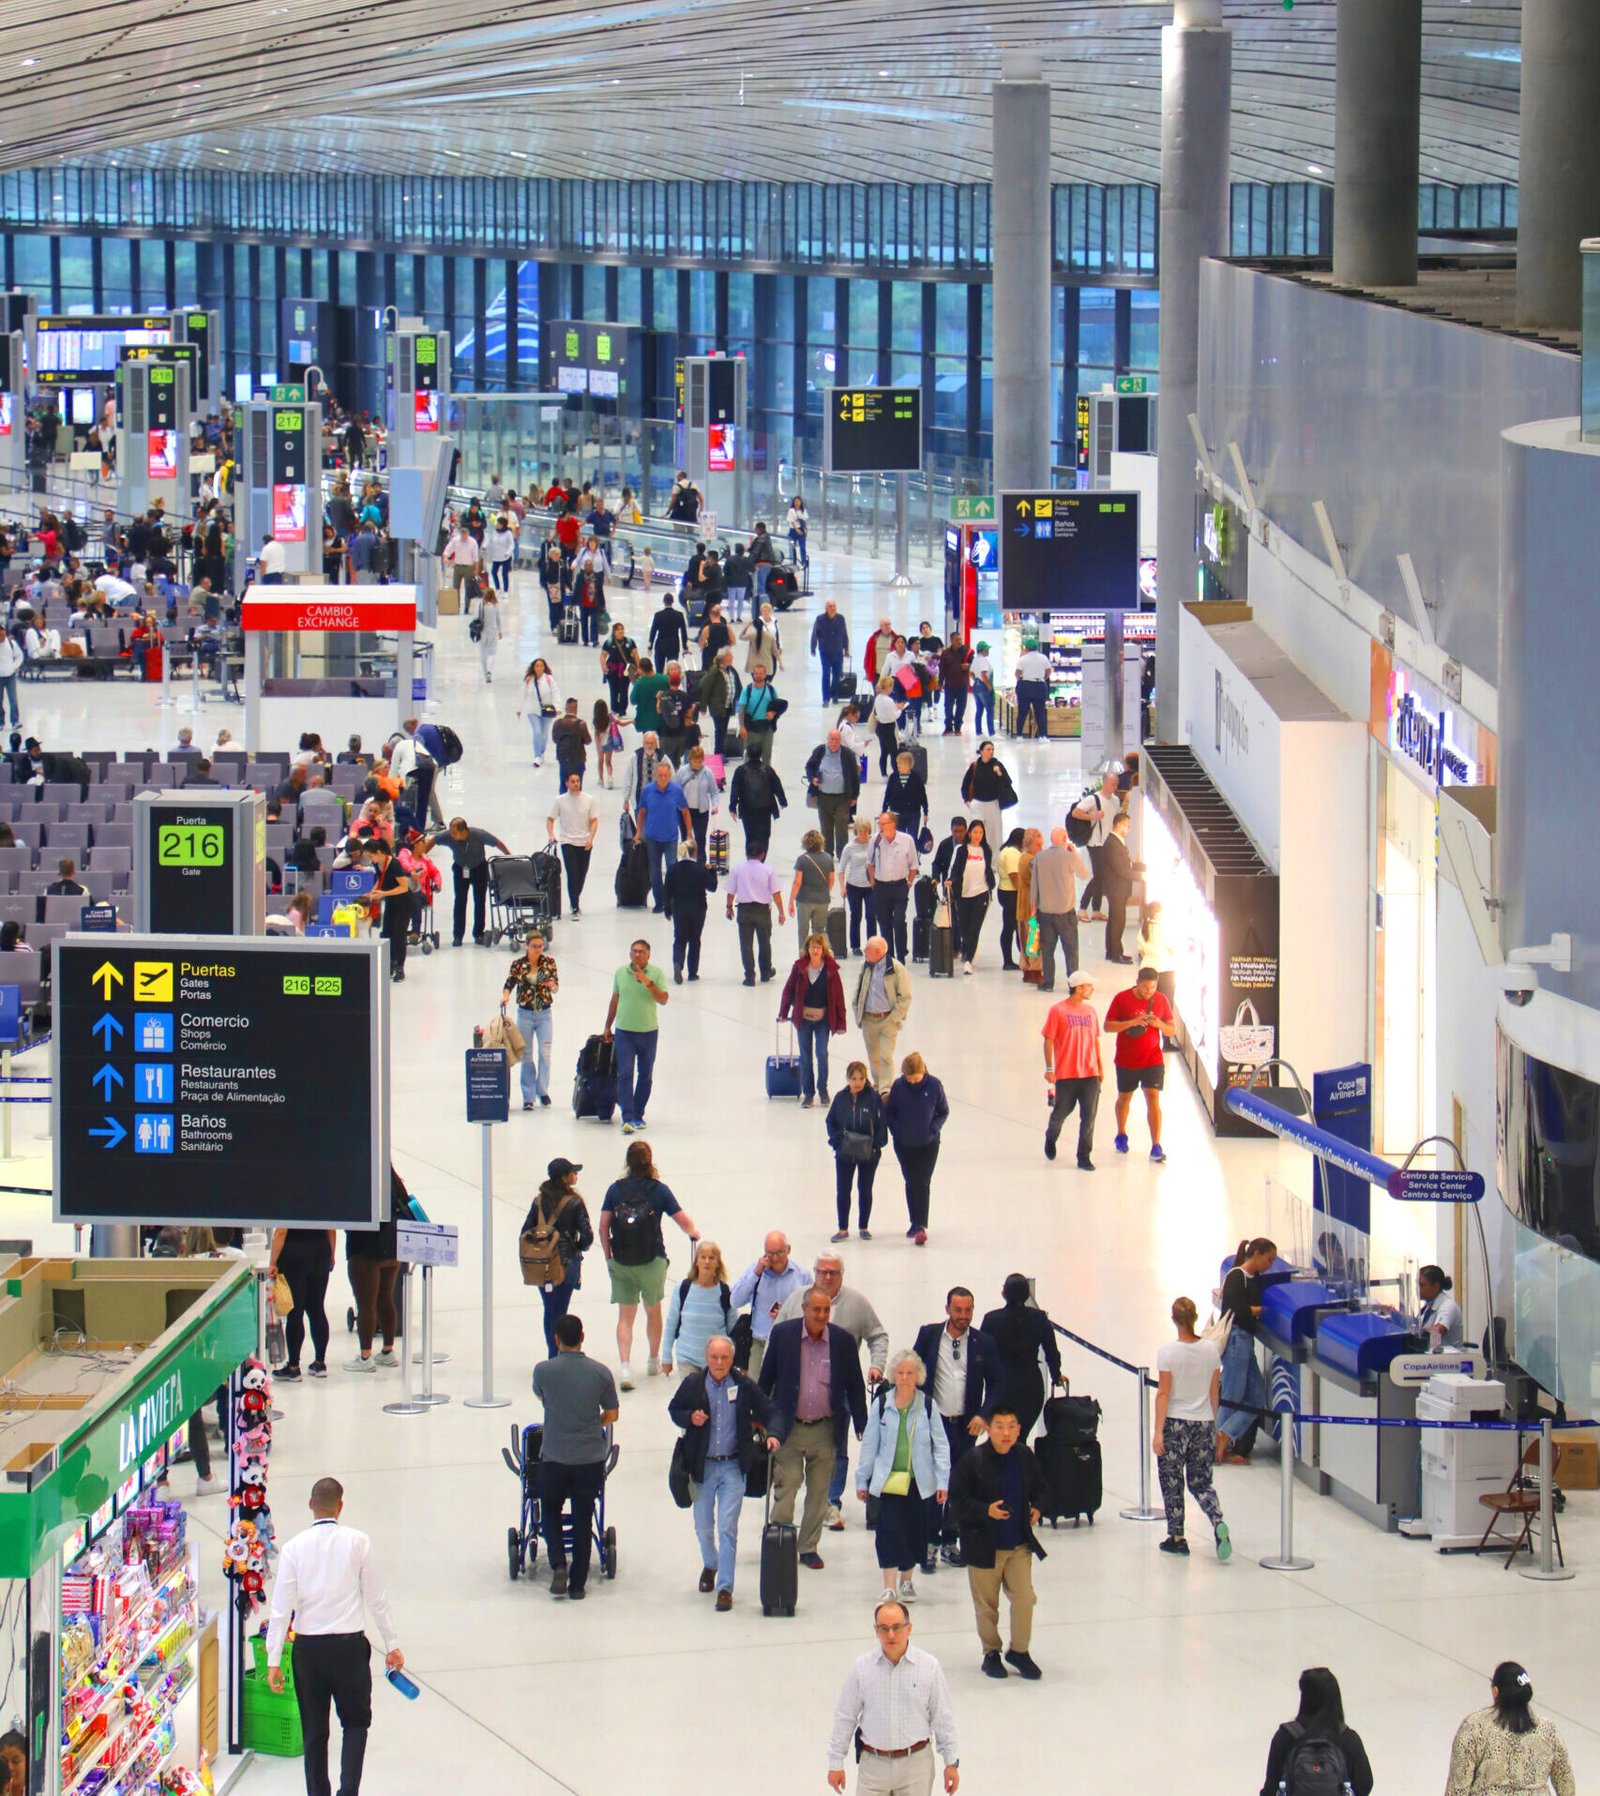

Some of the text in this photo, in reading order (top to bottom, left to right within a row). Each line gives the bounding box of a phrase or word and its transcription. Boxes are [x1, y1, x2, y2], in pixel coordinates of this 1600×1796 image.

[152, 369, 172, 382] 218
[277, 416, 300, 428] 217
[307, 606, 353, 617] CAMBIO
[298, 617, 359, 628] EXCHANGE
[176, 816, 207, 825] Puerta
[163, 832, 219, 859] 216
[181, 868, 201, 876] Gate
[180, 962, 236, 978] Puertas
[180, 978, 210, 988] Gates
[180, 989, 212, 1000] Portas
[180, 1012, 250, 1028] Comercio
[180, 1029, 211, 1040] Shops
[180, 1040, 227, 1051] Comércio
[180, 1064, 277, 1079] Restaurantes
[180, 1079, 239, 1090] Restaurants
[1337, 1080, 1356, 1091] Copa
[180, 1091, 286, 1104] Praça de Alimentação
[1329, 1089, 1356, 1101] Airlines
[180, 1113, 227, 1128] Baños
[180, 1129, 233, 1140] Bathrooms
[180, 1141, 224, 1151] Sanitário
[1400, 1171, 1473, 1180] Centro de Servicio
[1440, 1182, 1467, 1190] Center
[1401, 1190, 1429, 1198] Centro
[1442, 1191, 1472, 1200] Serviço
[1402, 1362, 1460, 1373] CopaAirlines
